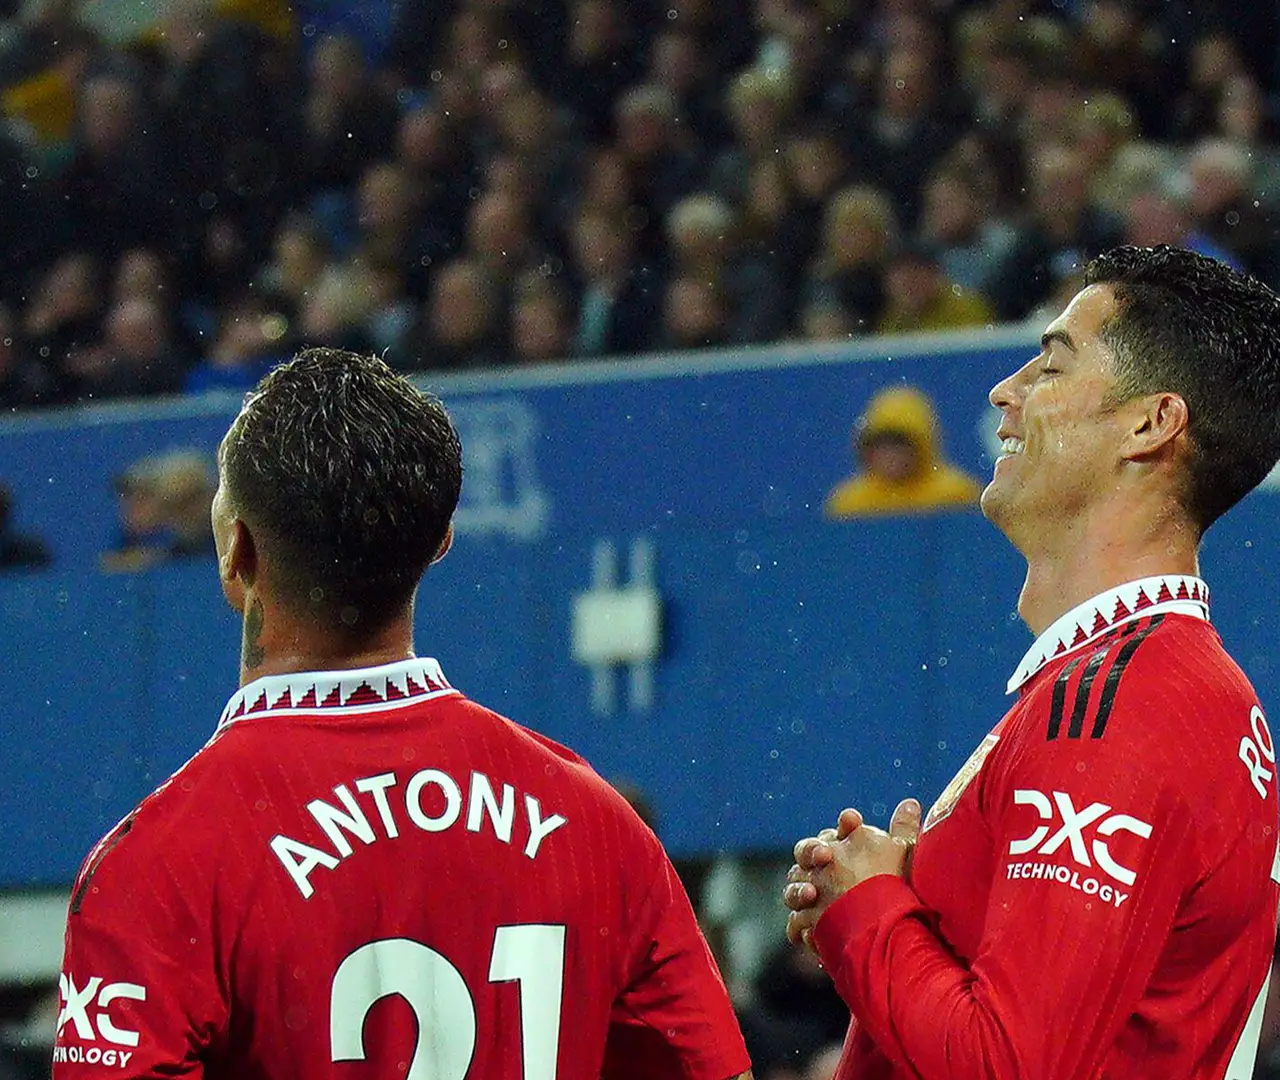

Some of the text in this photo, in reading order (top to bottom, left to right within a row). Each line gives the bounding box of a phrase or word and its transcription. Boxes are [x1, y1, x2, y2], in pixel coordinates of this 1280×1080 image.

[269, 767, 569, 900] ANTONY
[1009, 789, 1154, 887] DXC
[1005, 862, 1129, 908] TECHNOLOGY
